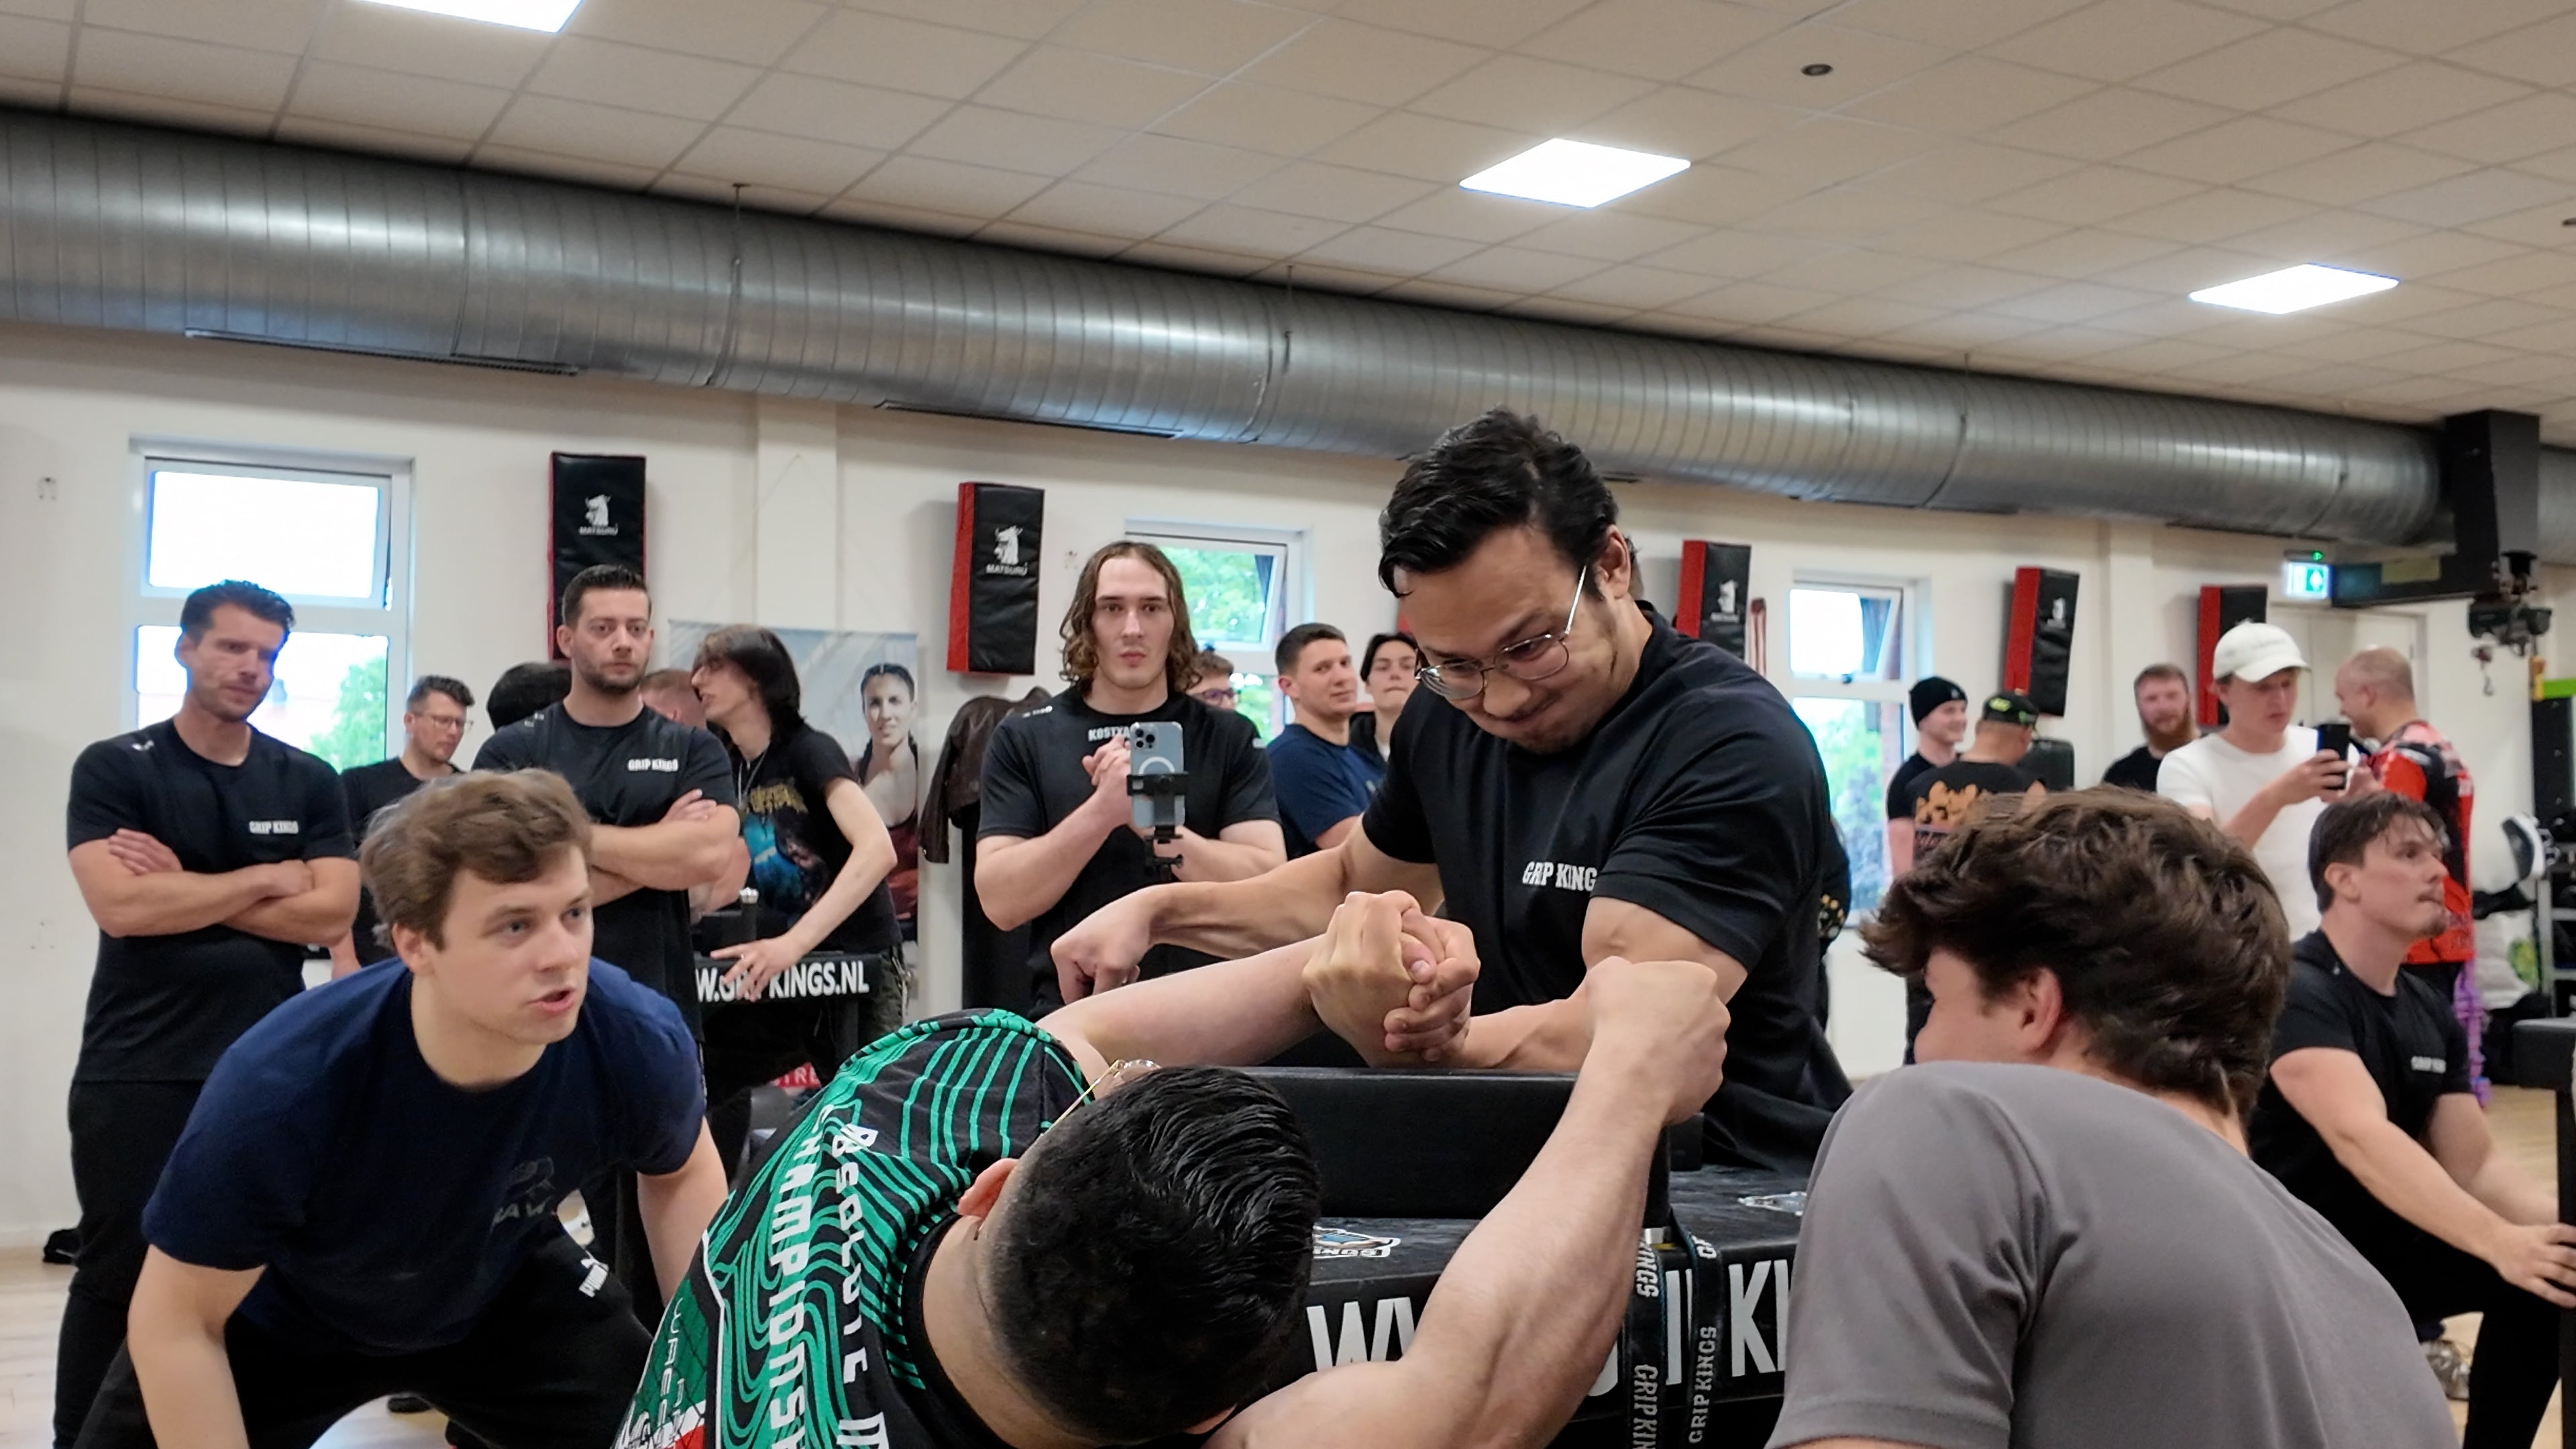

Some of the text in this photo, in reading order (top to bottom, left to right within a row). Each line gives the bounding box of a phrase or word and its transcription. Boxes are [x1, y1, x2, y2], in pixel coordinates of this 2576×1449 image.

[1633, 1364, 1658, 1415] GRIP
[1688, 1326, 1717, 1444] GRIP KINGS
